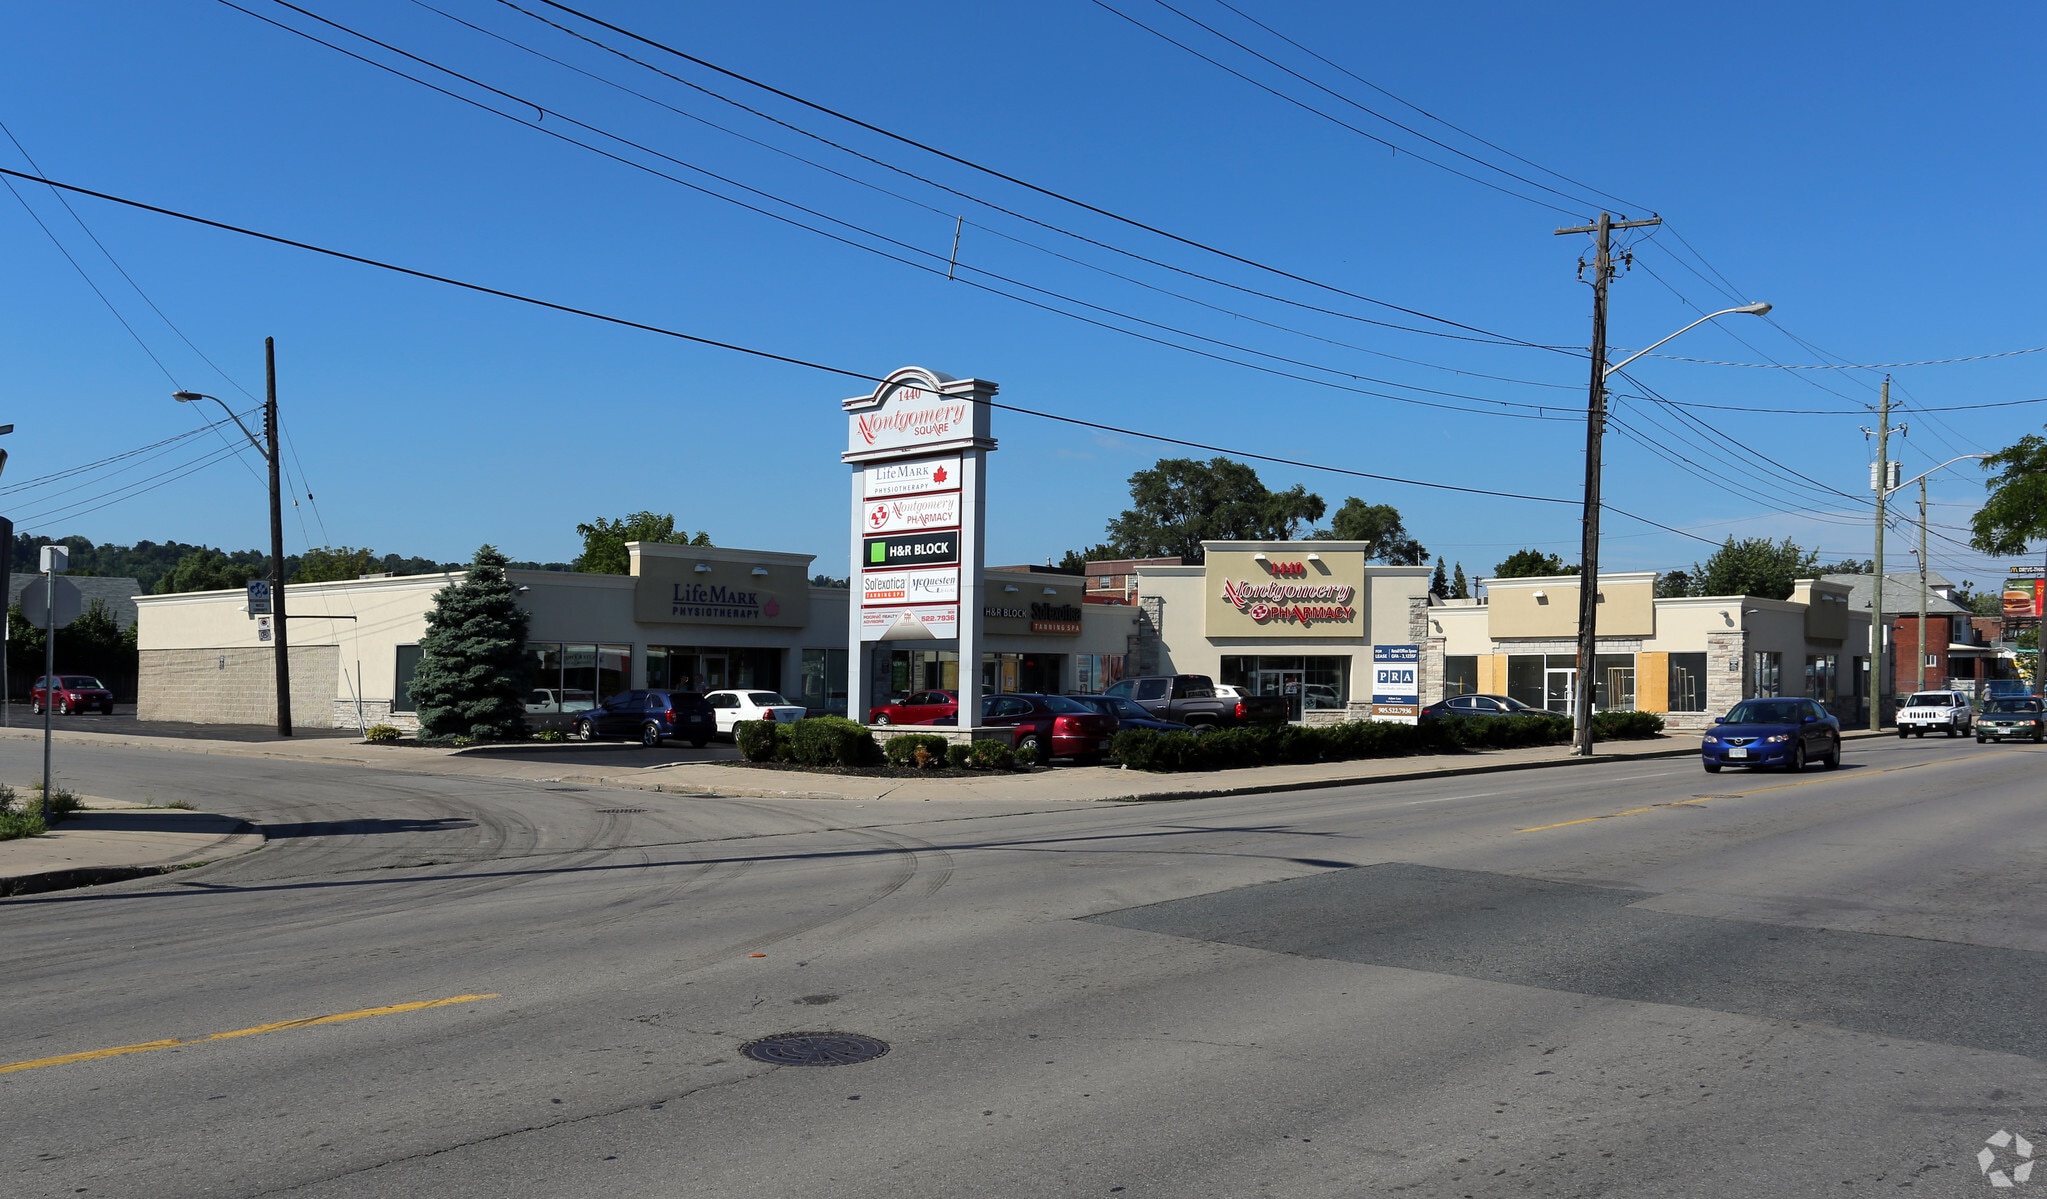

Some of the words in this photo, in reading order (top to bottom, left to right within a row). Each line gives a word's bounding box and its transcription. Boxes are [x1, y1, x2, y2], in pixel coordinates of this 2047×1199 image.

[898, 389, 921, 401] 1440
[857, 403, 967, 445] Montgomery
[914, 422, 949, 437] SQUARE
[875, 483, 929, 494] PHYSIOTHERAPY
[892, 498, 955, 519] Montgomery
[906, 512, 953, 526] PHARMACY
[889, 544, 912, 557] H&R
[914, 541, 949, 555] BLOCK
[1270, 561, 1304, 575] 1440
[912, 575, 955, 593] McQuesten
[866, 591, 892, 599] TANNING
[893, 590, 905, 598] SPA
[1221, 577, 1352, 609] Montgomery
[672, 606, 759, 619] PHYSIOTHERAPY
[921, 614, 955, 622] 522.7936
[985, 608, 1002, 617] H&R
[1003, 608, 1027, 618] BLOCK
[1271, 604, 1353, 624] PHARMACY
[1034, 623, 1065, 631] TANNING
